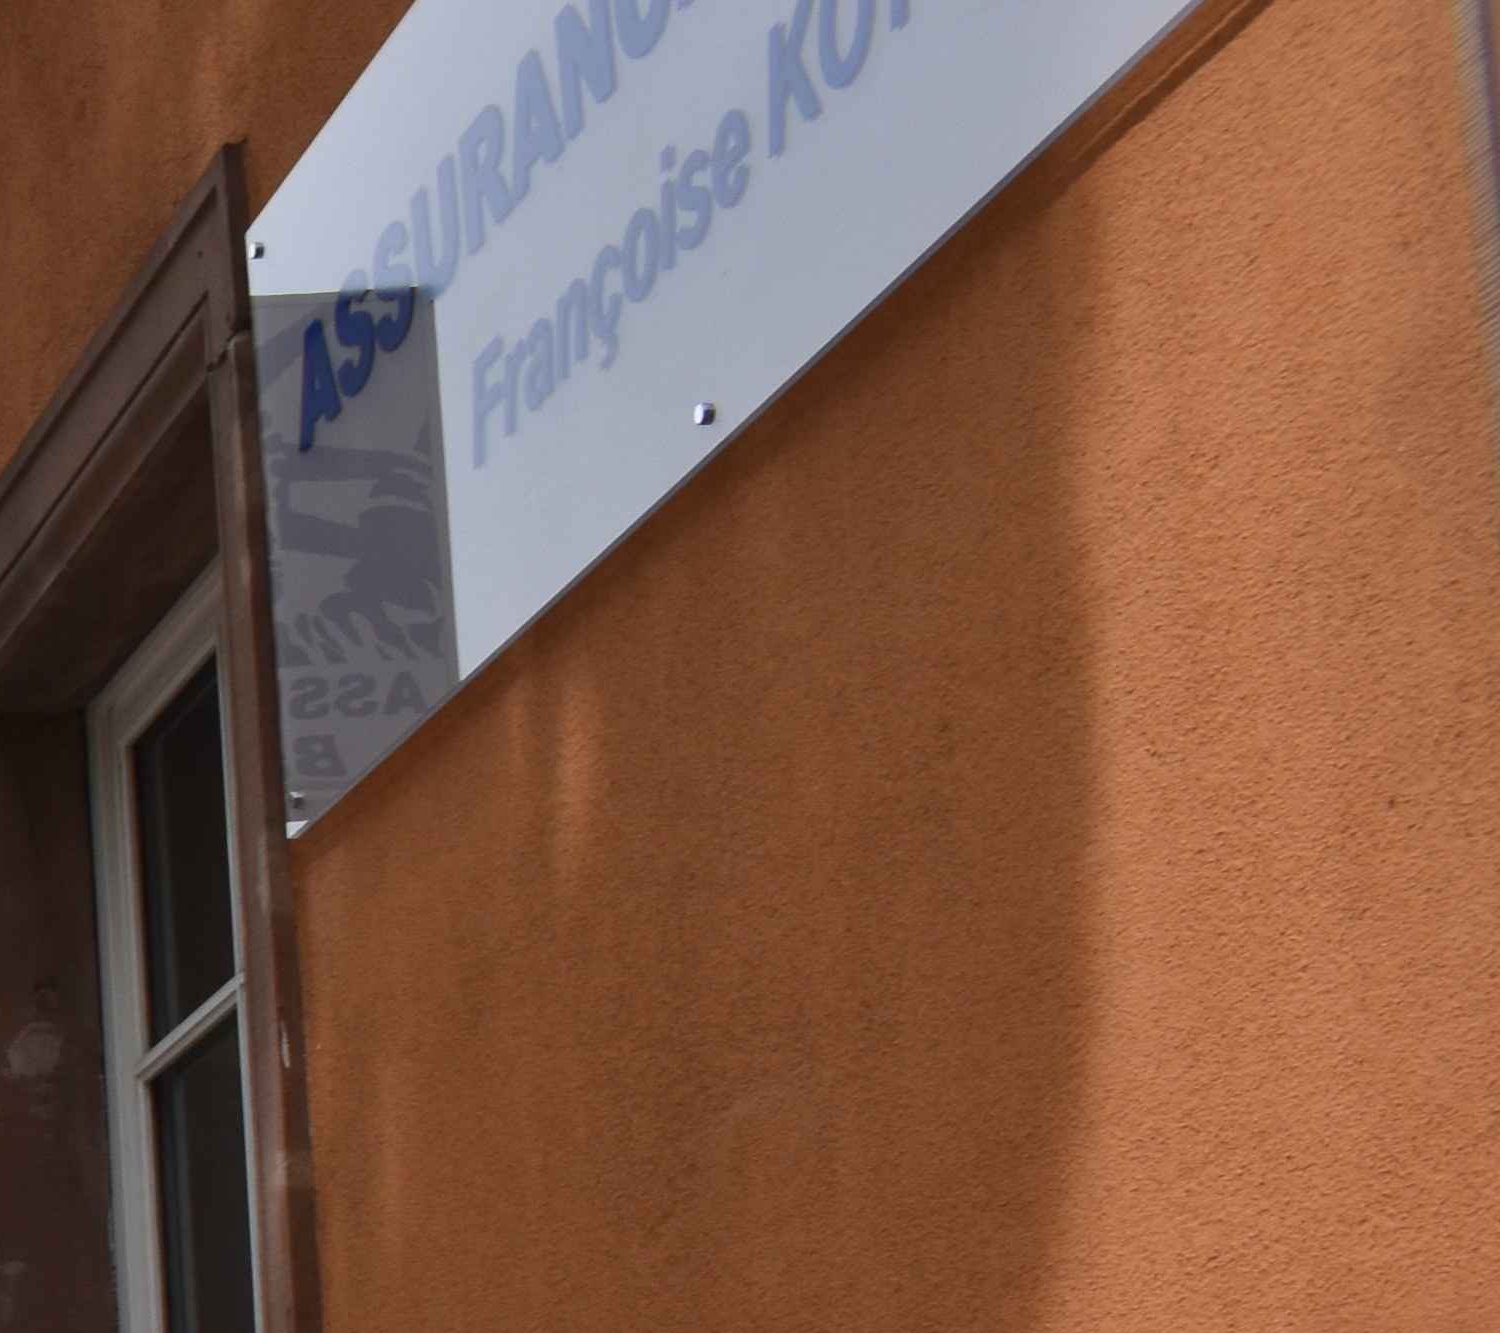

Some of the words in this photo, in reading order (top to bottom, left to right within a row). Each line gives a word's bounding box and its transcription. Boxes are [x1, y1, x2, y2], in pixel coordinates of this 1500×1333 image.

[299, 0, 694, 454] ASSURAN
[471, 109, 751, 469] Françoise
[767, 0, 911, 160] KO
